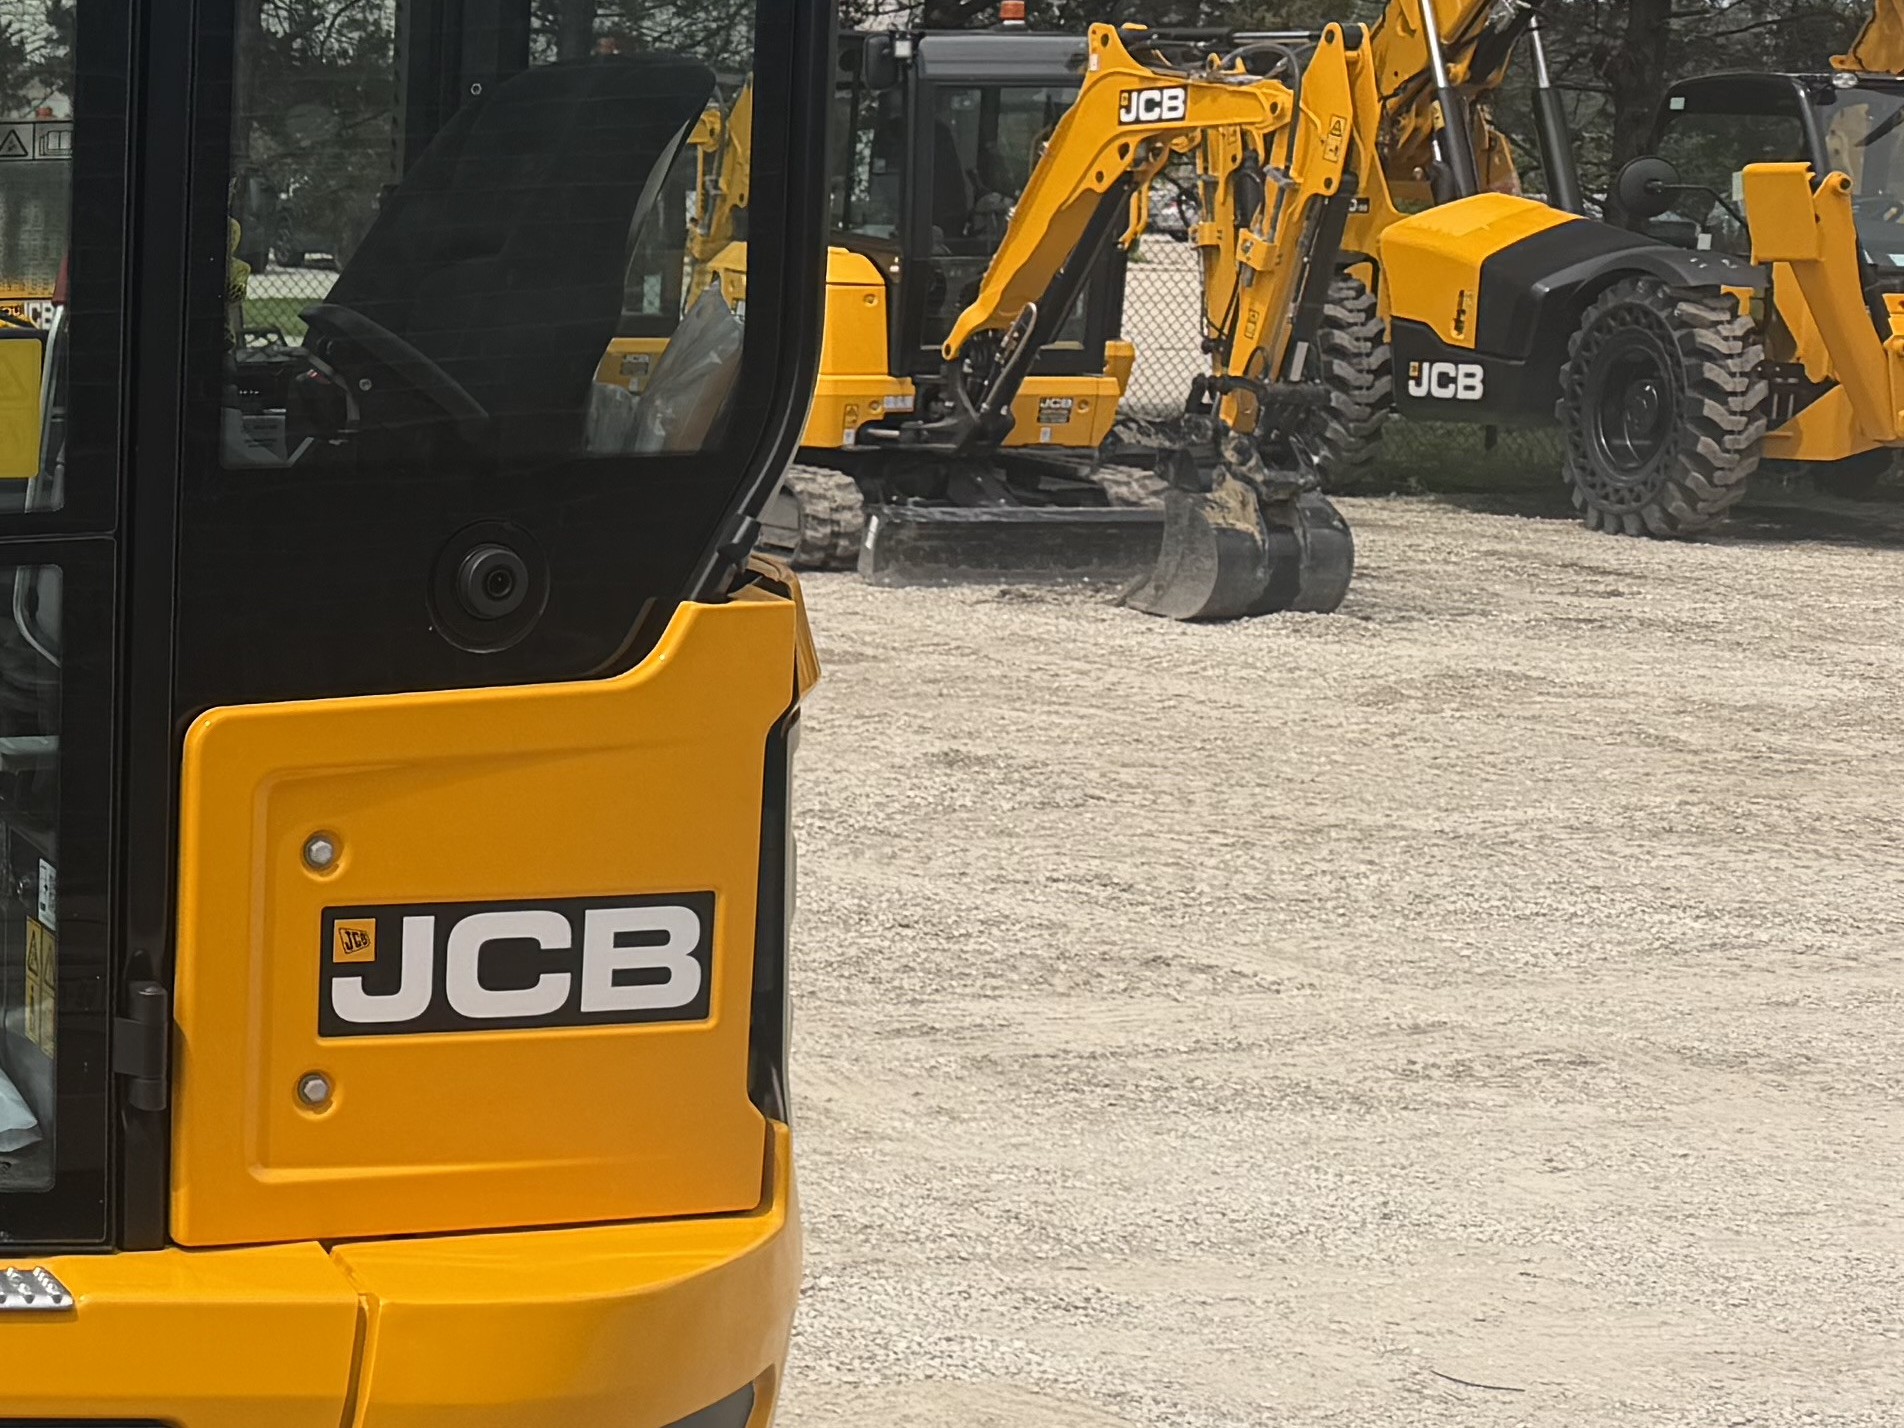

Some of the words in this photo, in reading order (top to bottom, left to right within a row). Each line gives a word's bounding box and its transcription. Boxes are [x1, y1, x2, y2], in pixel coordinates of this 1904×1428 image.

[1120, 88, 1185, 122] JCB
[1409, 362, 1484, 400] JCB
[1040, 399, 1072, 408] JCB
[331, 905, 702, 1023] JCB
